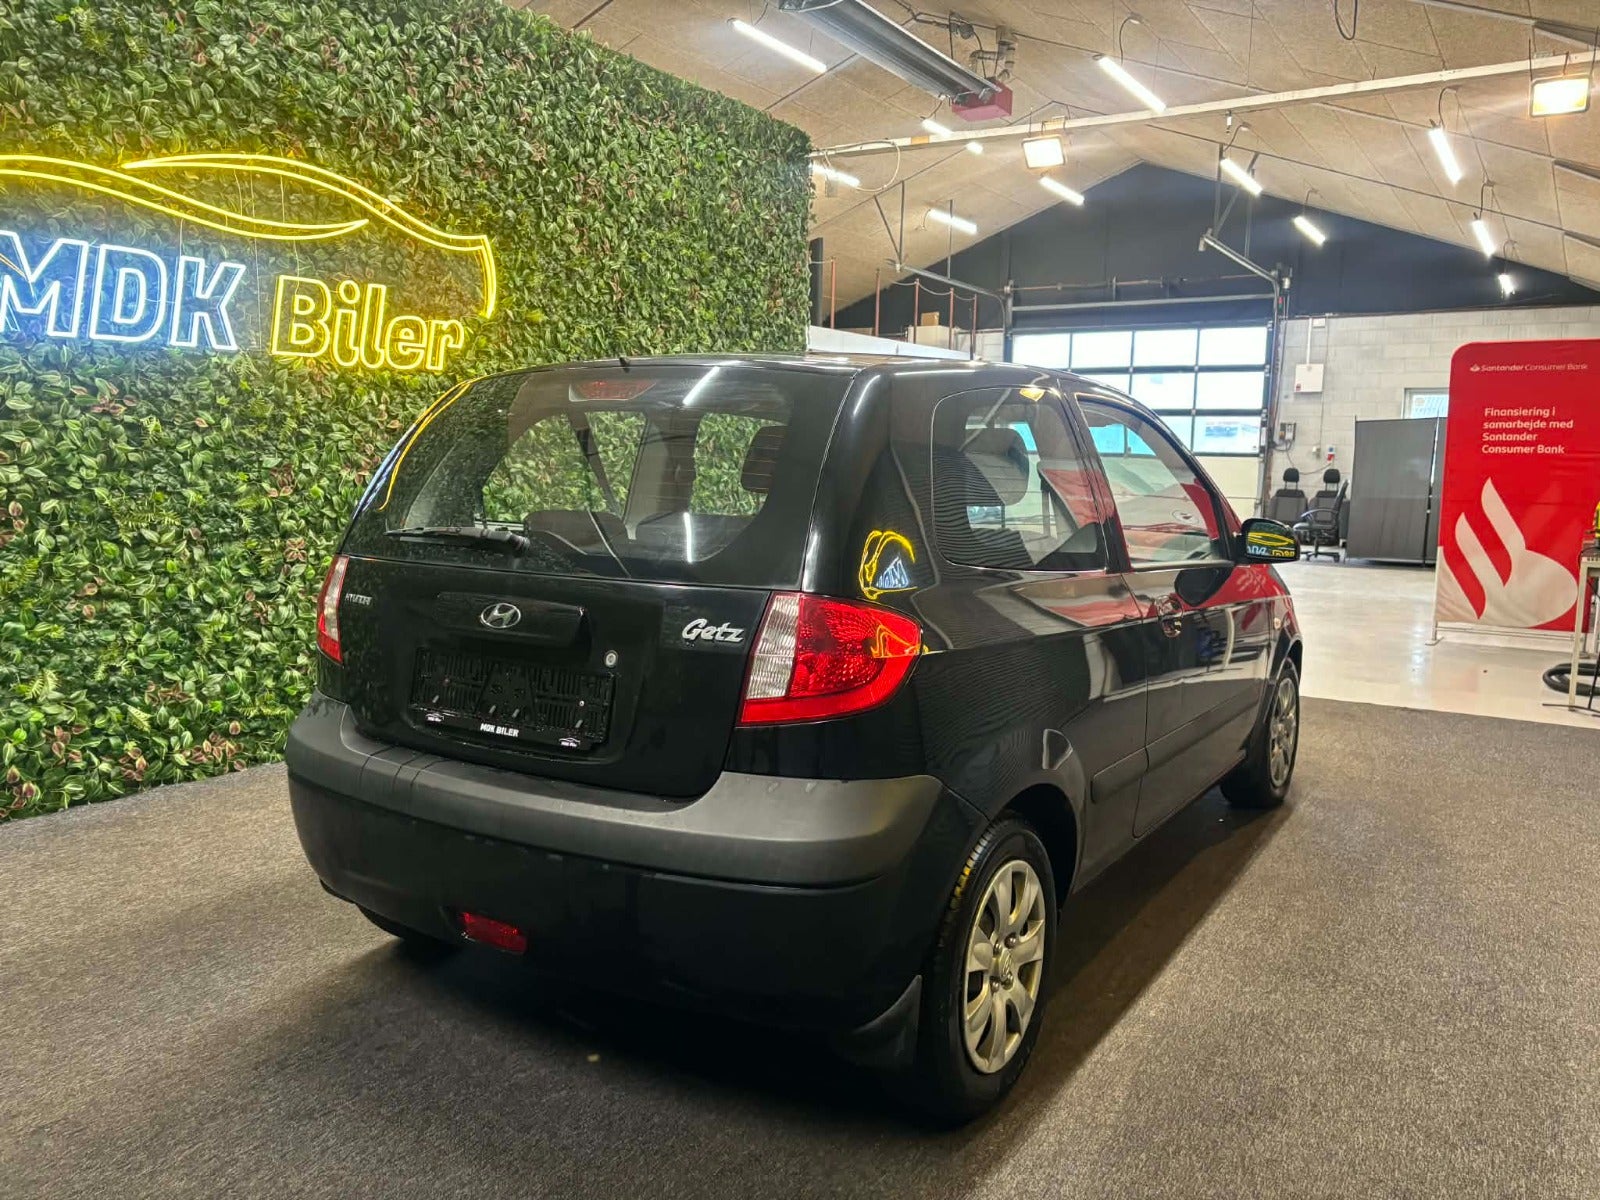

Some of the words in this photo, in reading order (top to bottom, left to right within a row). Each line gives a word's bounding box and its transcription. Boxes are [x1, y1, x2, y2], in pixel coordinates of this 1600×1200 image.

[0, 230, 246, 351] MDK
[271, 274, 465, 372] Biler
[1481, 364, 1524, 372] Santander
[1524, 363, 1566, 371] Consumer
[1484, 407, 1550, 418] Finansiering
[1483, 420, 1547, 431] samarbejde
[1549, 420, 1574, 429] med
[1482, 432, 1538, 441] Santander
[1482, 444, 1535, 454] Consumer
[1537, 444, 1565, 454] Bank
[682, 618, 744, 642] Getz
[480, 723, 496, 732] MDK
[496, 726, 519, 737] BILER
